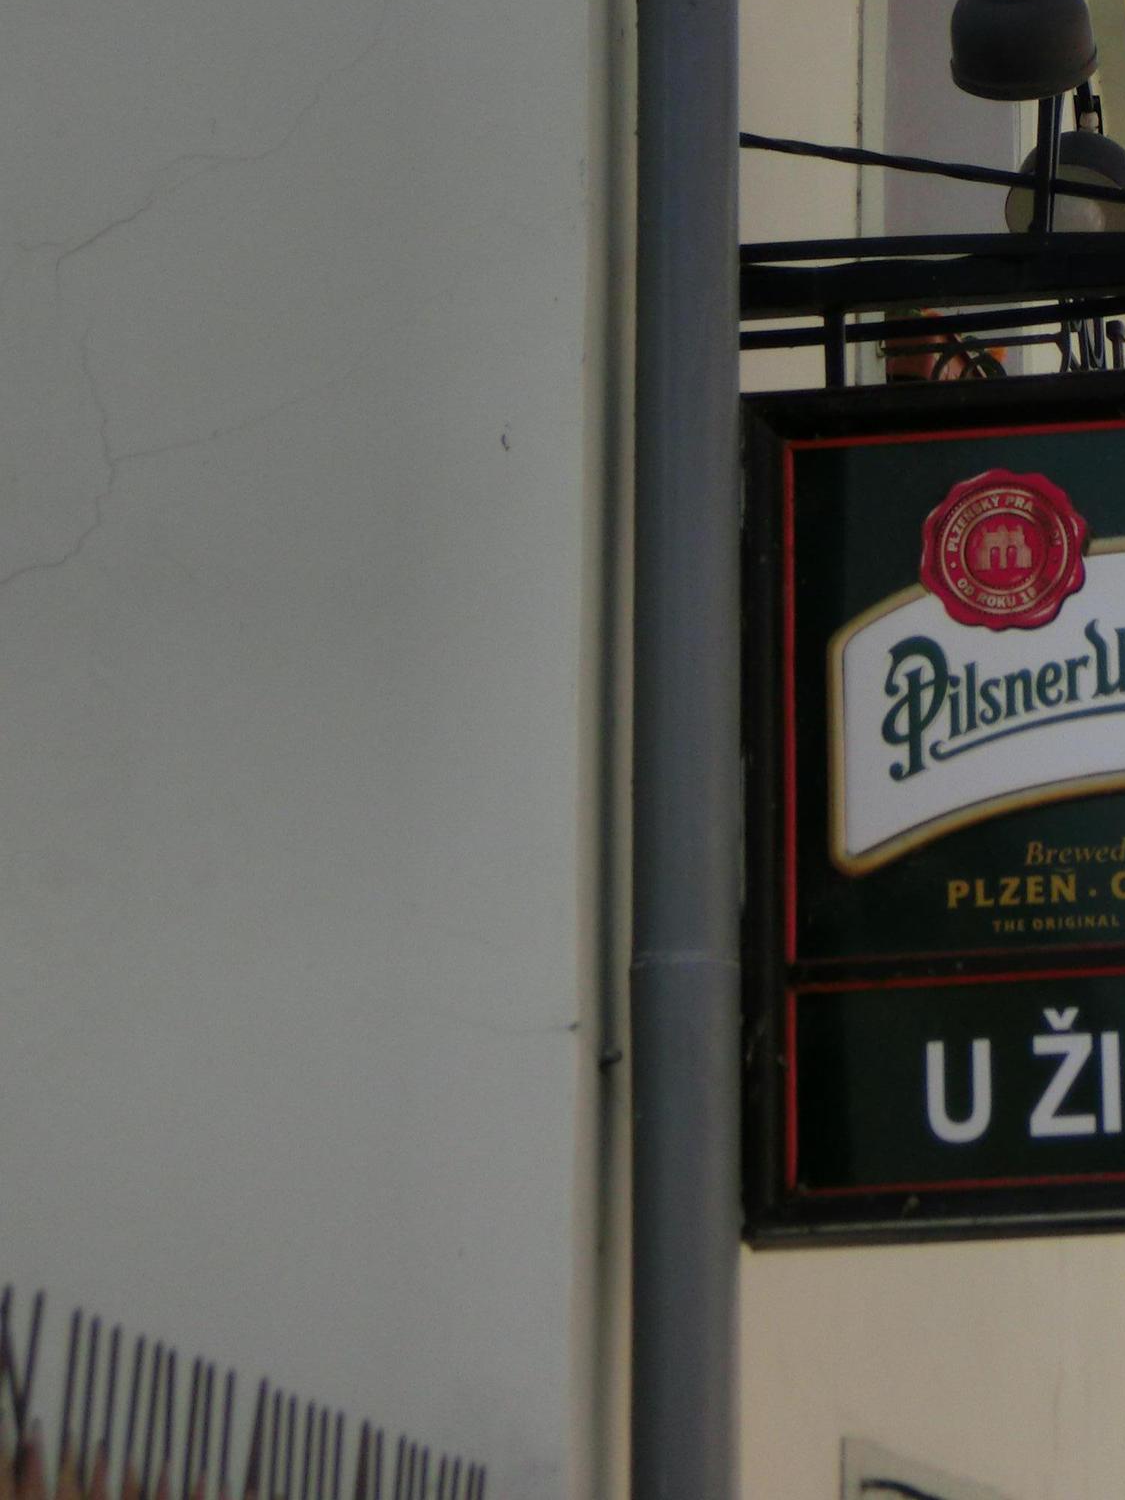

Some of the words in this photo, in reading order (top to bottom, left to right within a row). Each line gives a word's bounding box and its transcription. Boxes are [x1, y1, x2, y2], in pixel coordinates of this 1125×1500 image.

[881, 631, 1090, 781] Pilsner
[946, 867, 1077, 910] PLZEŇ
[992, 919, 1026, 933] THE
[1032, 912, 1121, 931] ORIGINAL
[925, 1038, 994, 1145] U
